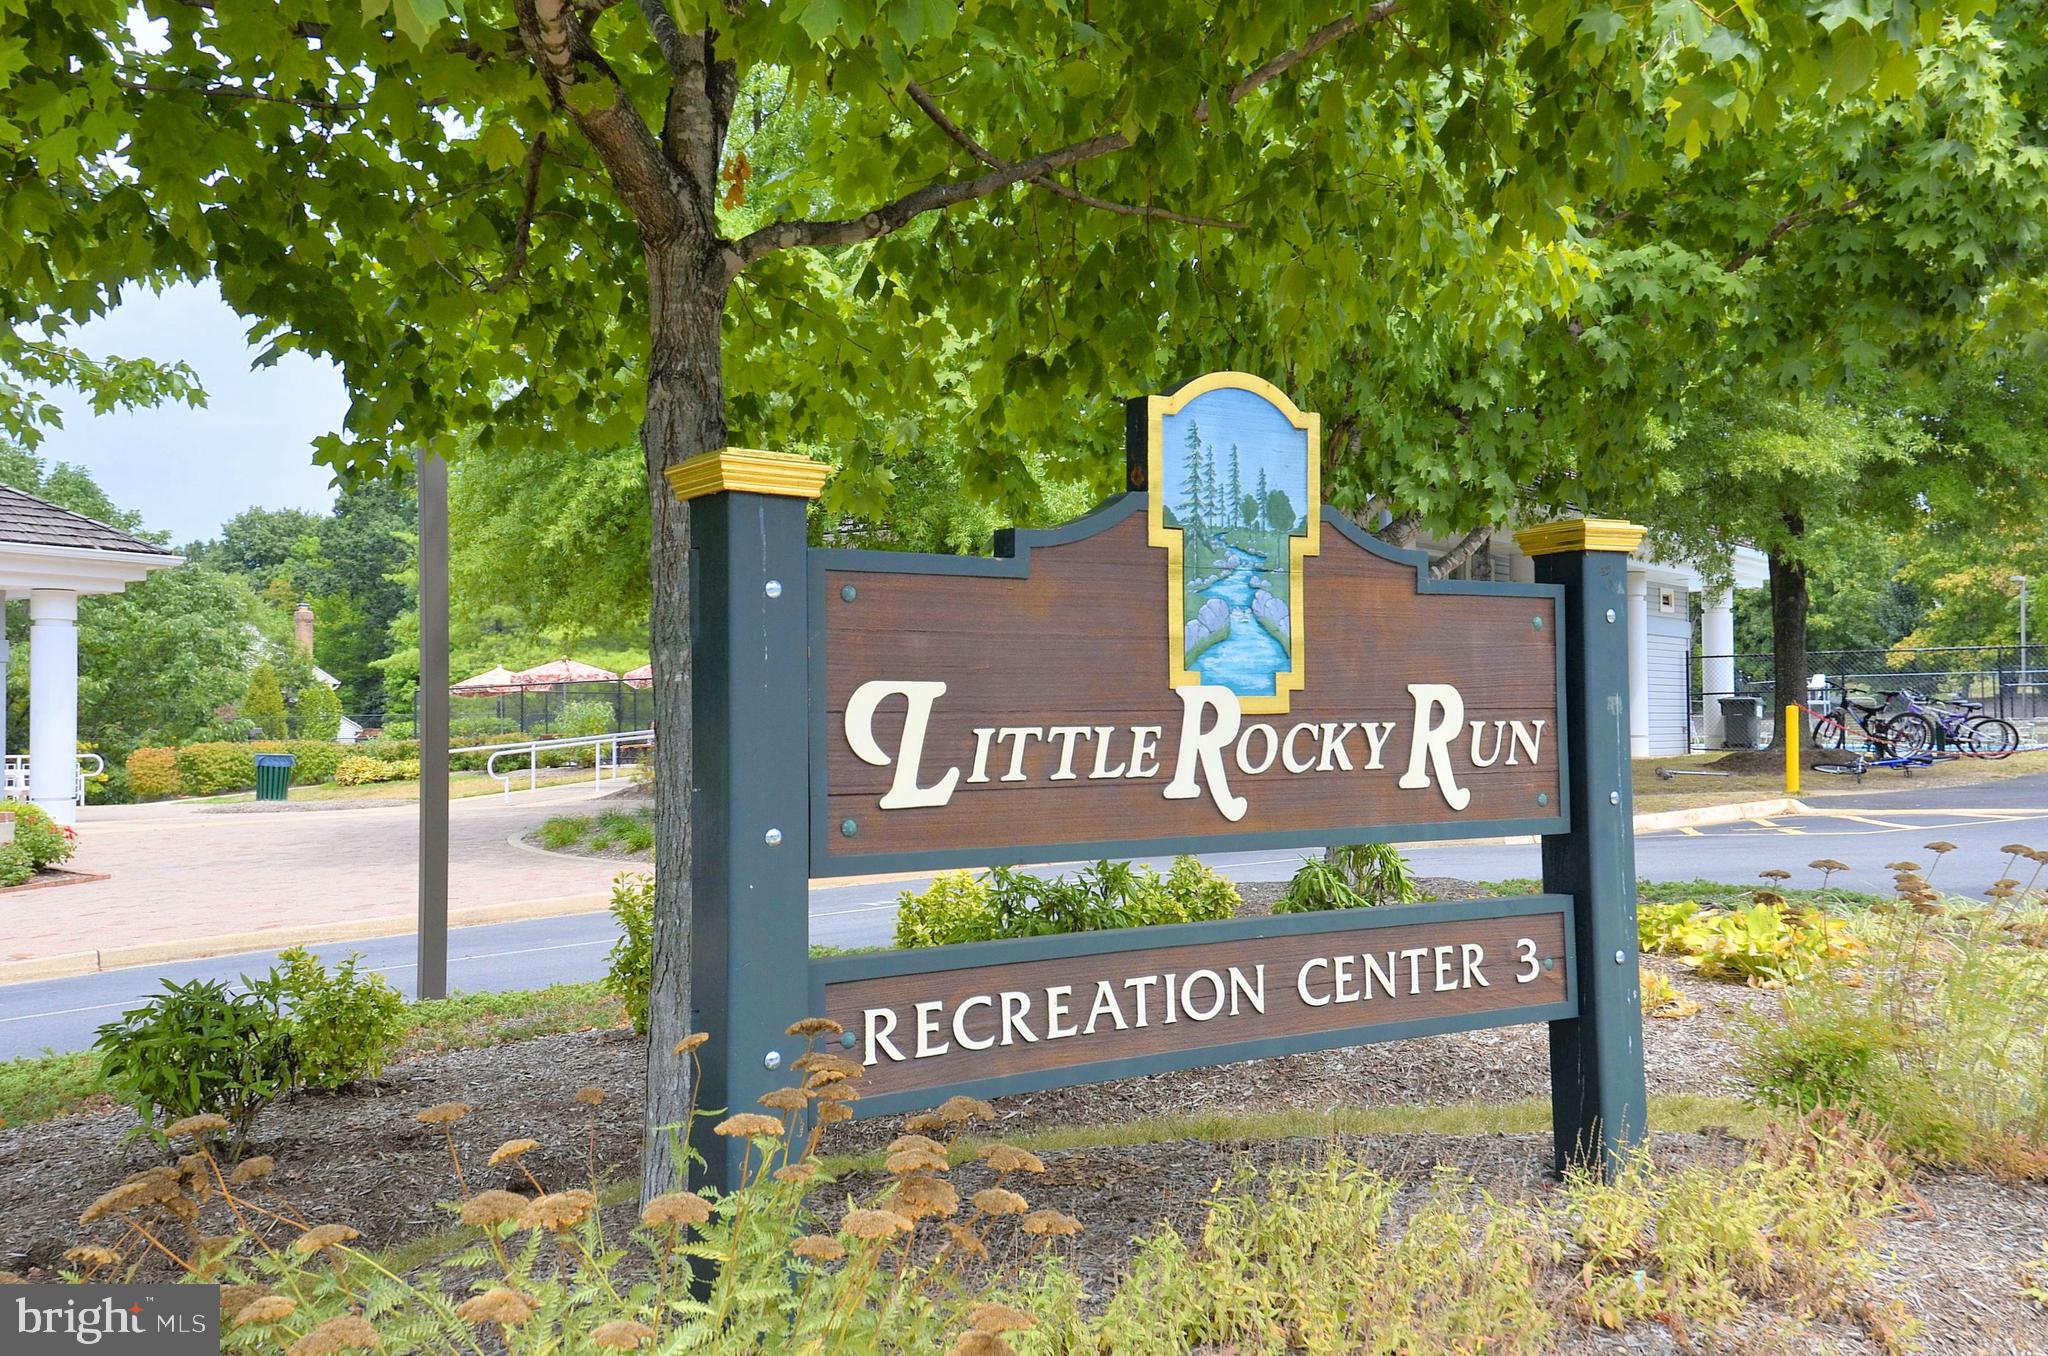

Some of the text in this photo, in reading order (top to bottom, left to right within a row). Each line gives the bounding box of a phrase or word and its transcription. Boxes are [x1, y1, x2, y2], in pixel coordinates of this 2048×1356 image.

[844, 680, 1547, 822] LITTLE ROCKY RUN
[861, 938, 1542, 1067] RECREATION CENTER 3
